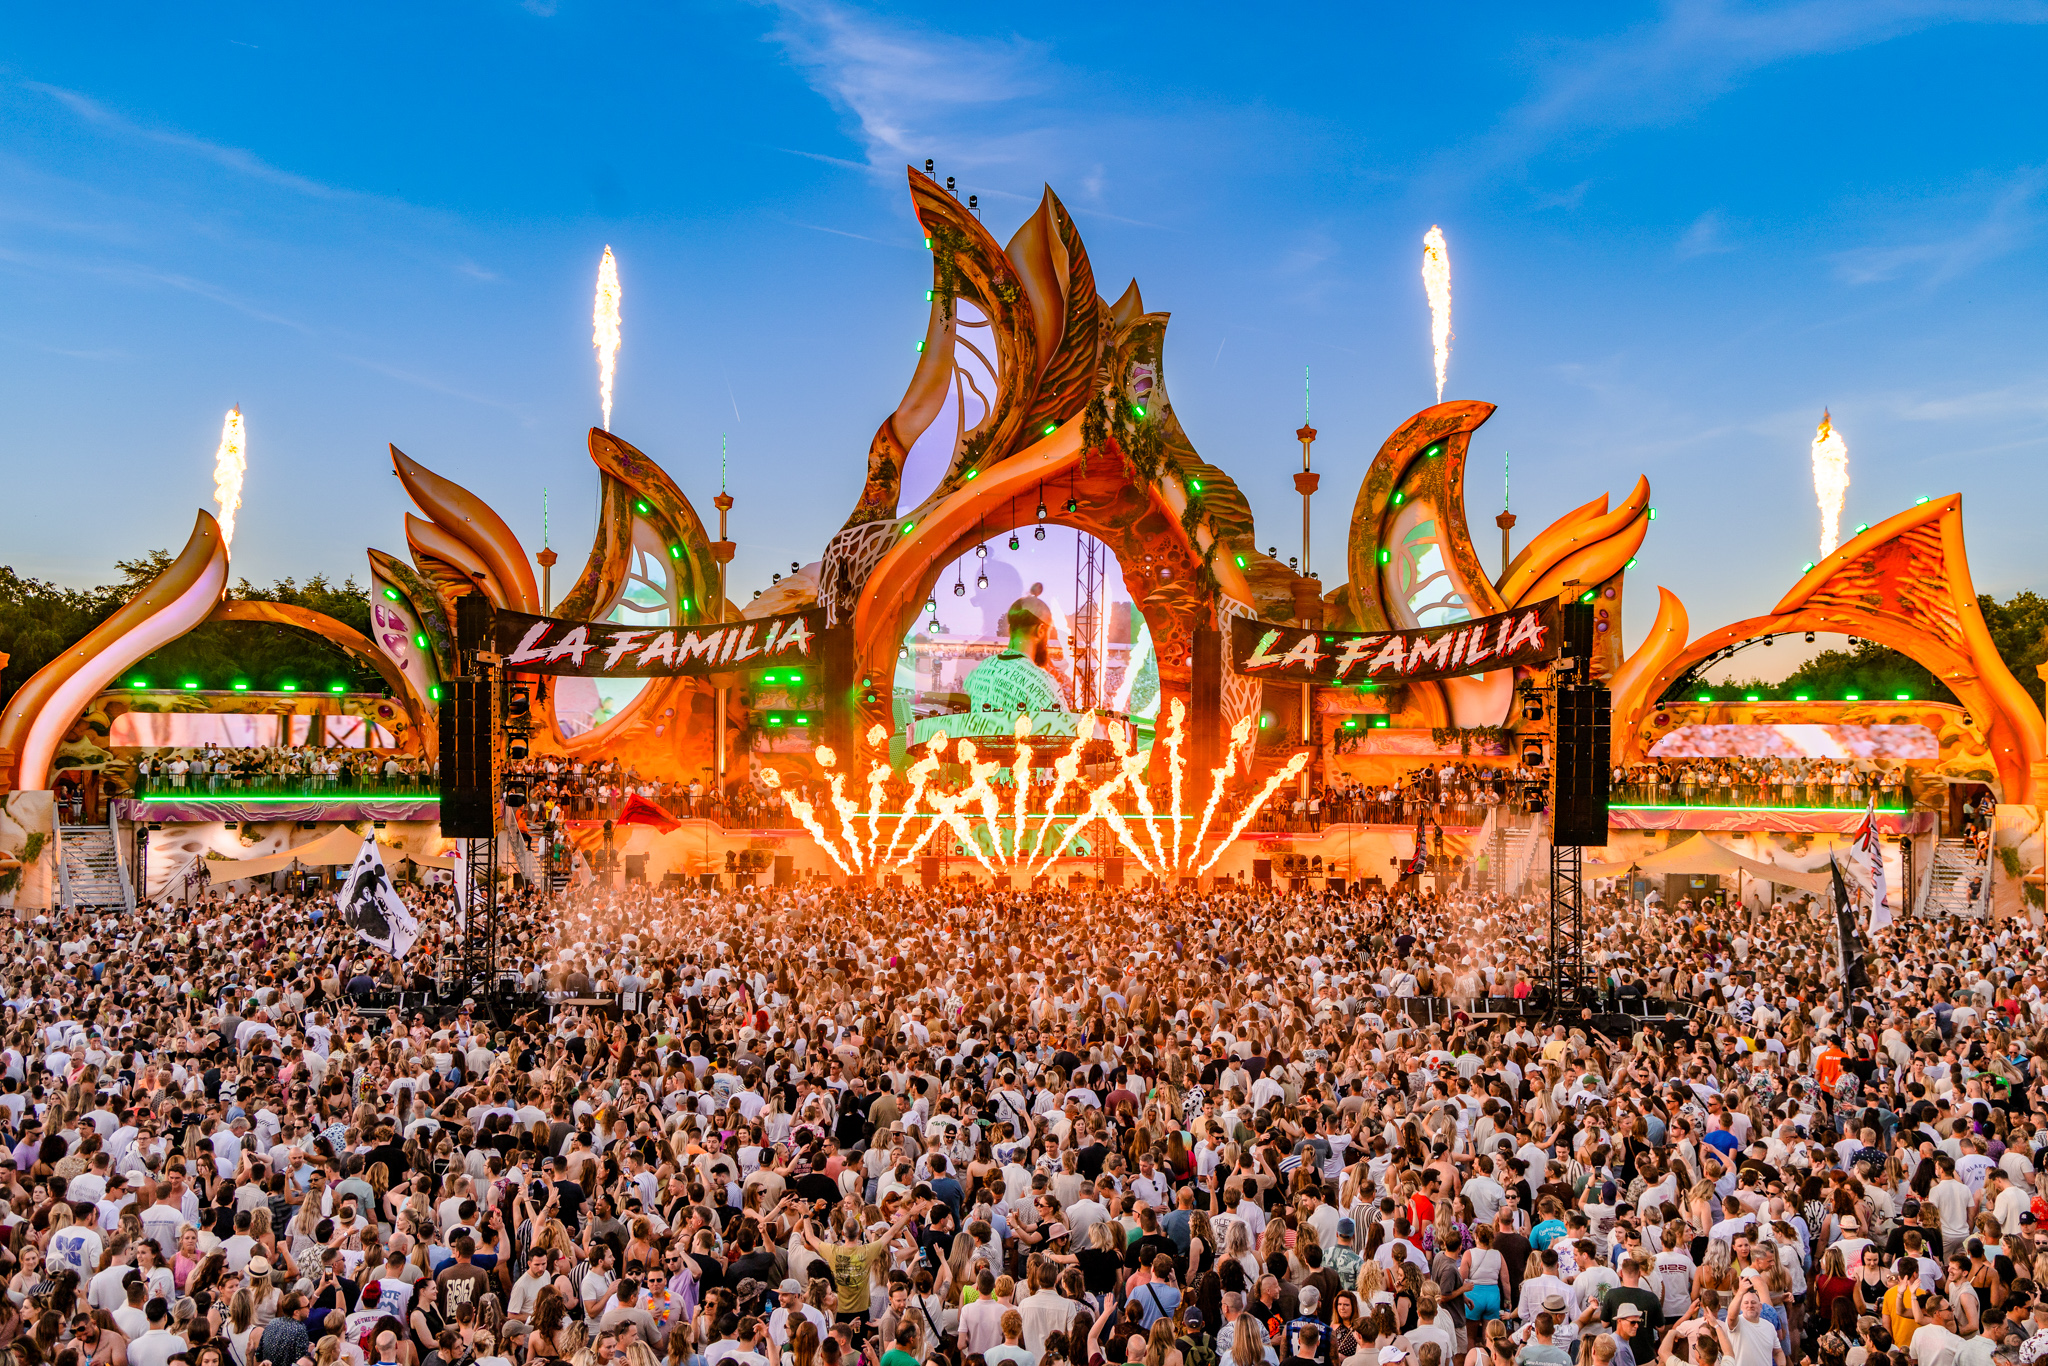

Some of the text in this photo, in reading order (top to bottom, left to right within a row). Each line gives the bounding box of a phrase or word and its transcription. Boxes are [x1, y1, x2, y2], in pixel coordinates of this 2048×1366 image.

[503, 616, 815, 672] LA FAMILIA
[1241, 609, 1549, 679] LA FAMILIA
[1009, 670, 1029, 687] BON
